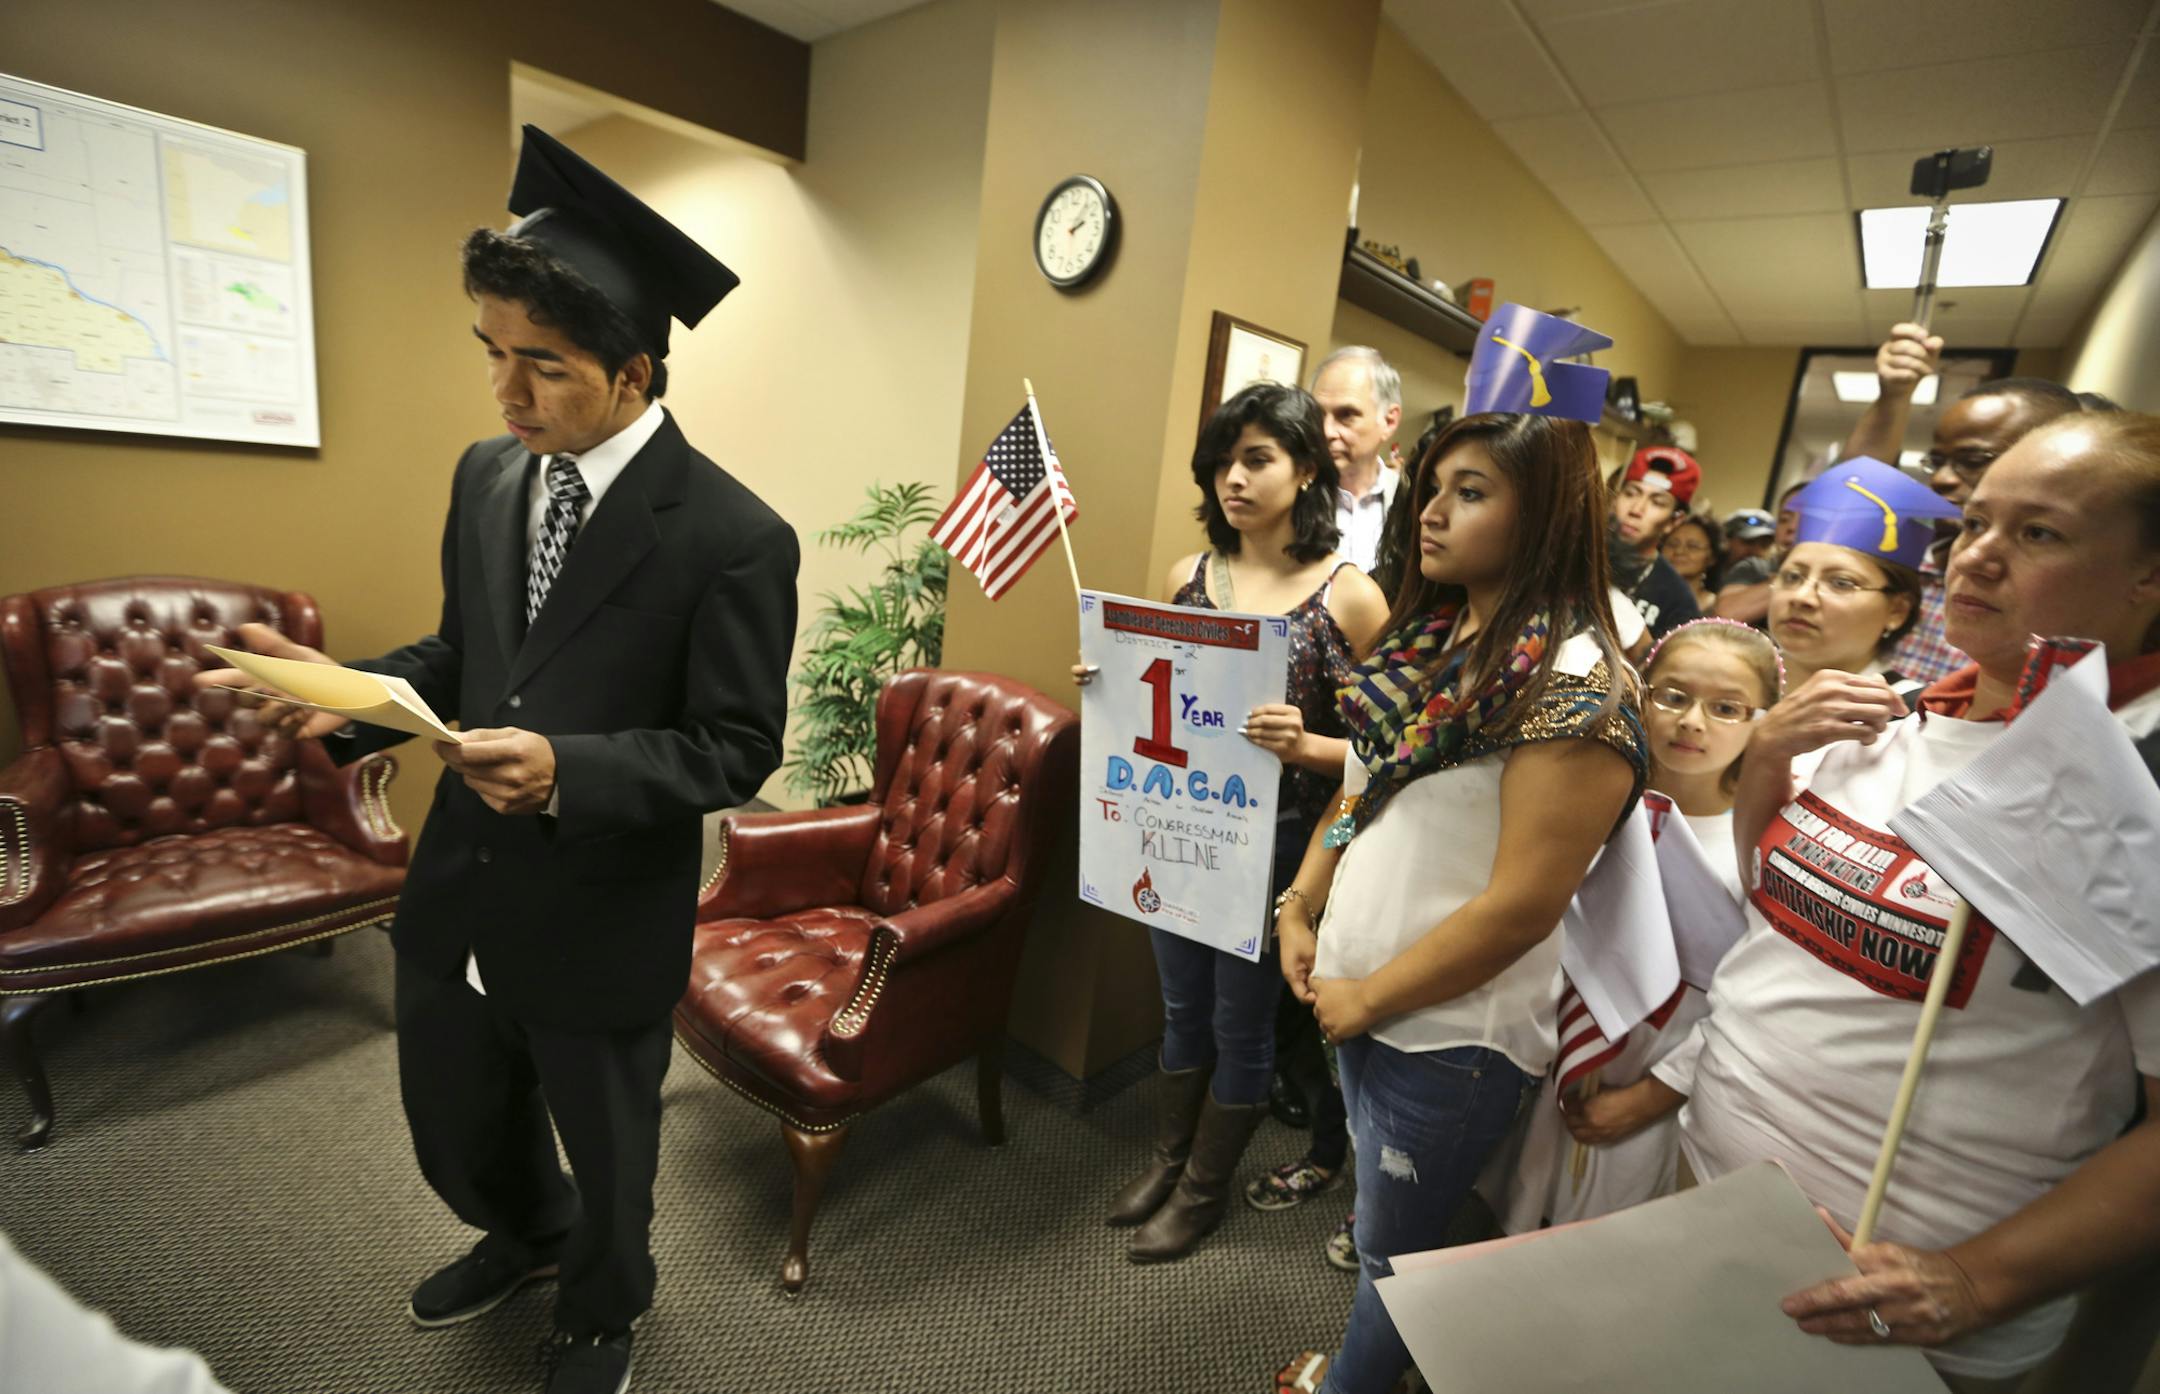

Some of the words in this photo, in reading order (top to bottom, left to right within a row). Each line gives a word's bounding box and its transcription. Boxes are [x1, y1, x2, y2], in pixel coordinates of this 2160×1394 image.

[1198, 621, 1230, 641] Civiles
[1106, 754, 1259, 809] D.A.C.A.
[1134, 806, 1249, 846] CONGRESSMAN
[1140, 829, 1222, 871] KLINE
[1763, 865, 1858, 950] CITIZENSHIP
[1860, 926, 1938, 982] NOW
[1877, 911, 1947, 948] MINNESOT
